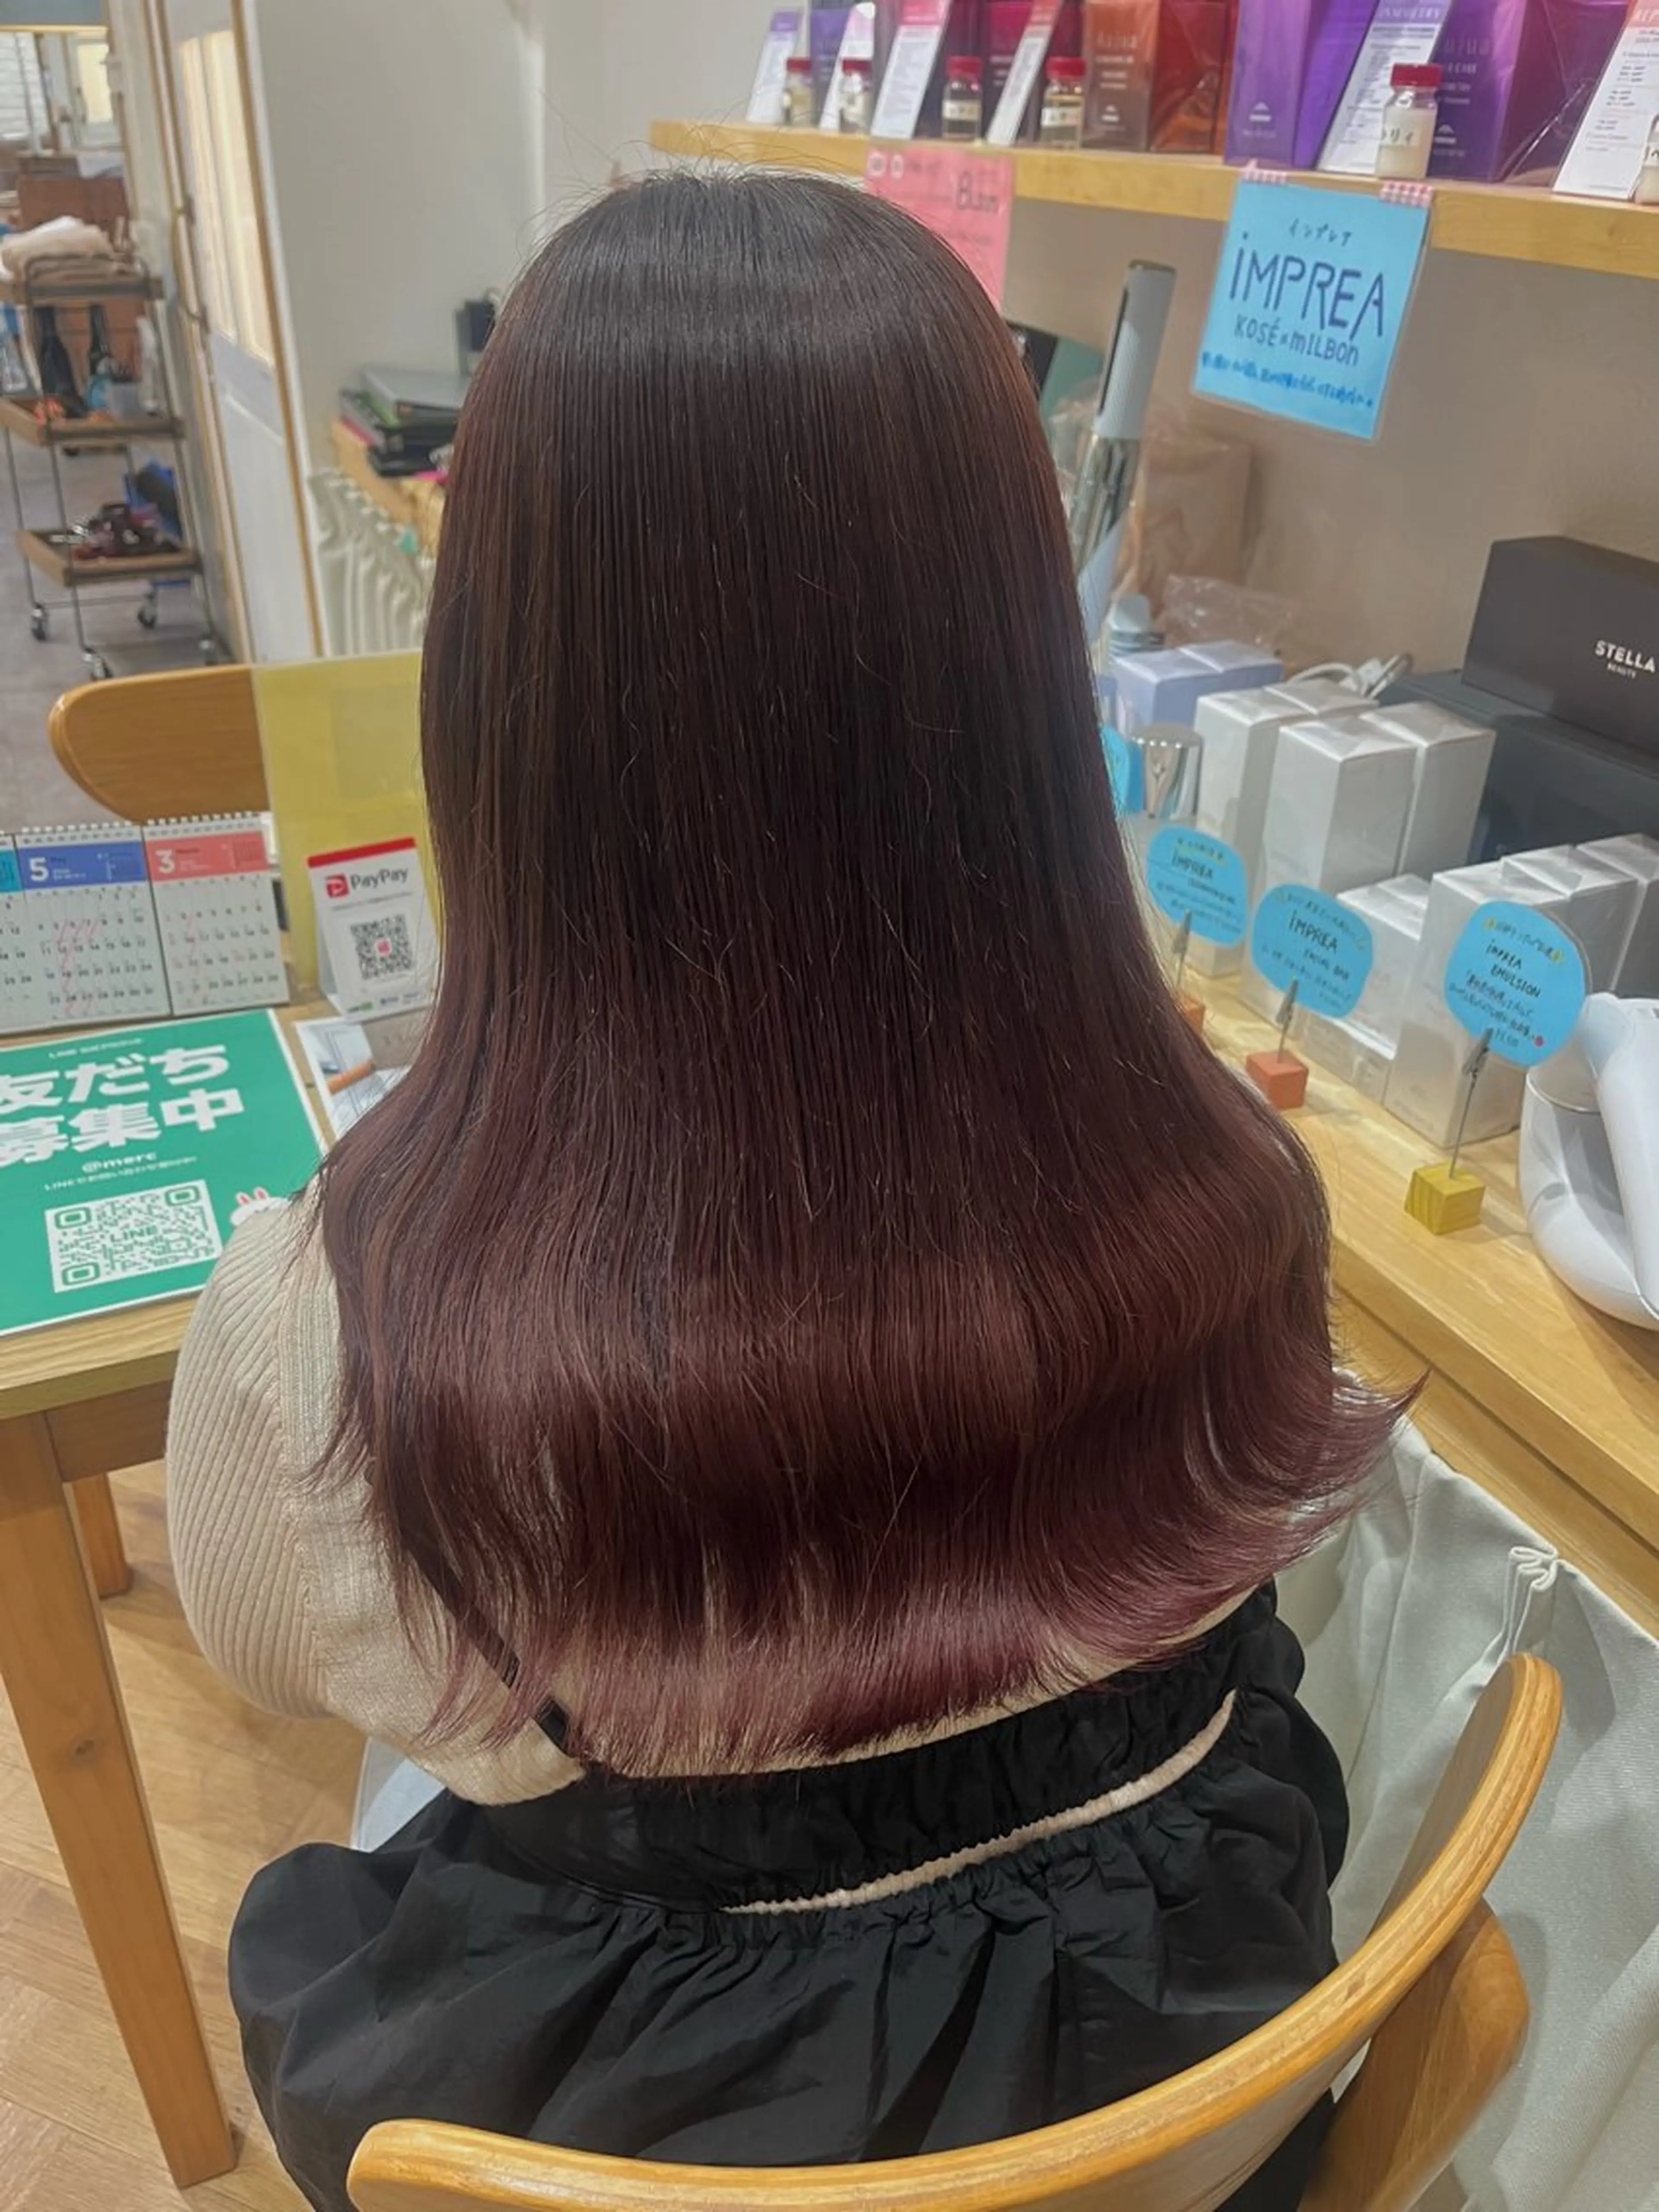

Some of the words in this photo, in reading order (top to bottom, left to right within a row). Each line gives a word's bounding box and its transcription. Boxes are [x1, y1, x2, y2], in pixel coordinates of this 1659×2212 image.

[1595, 639, 1656, 673] STELLA
[29, 856, 49, 883] 5
[156, 849, 174, 874] 3
[350, 868, 408, 890] PayPay
[0, 1045, 229, 1115] 友だち
[0, 1088, 245, 1166] 募集中
[111, 1225, 160, 1243] LINE
